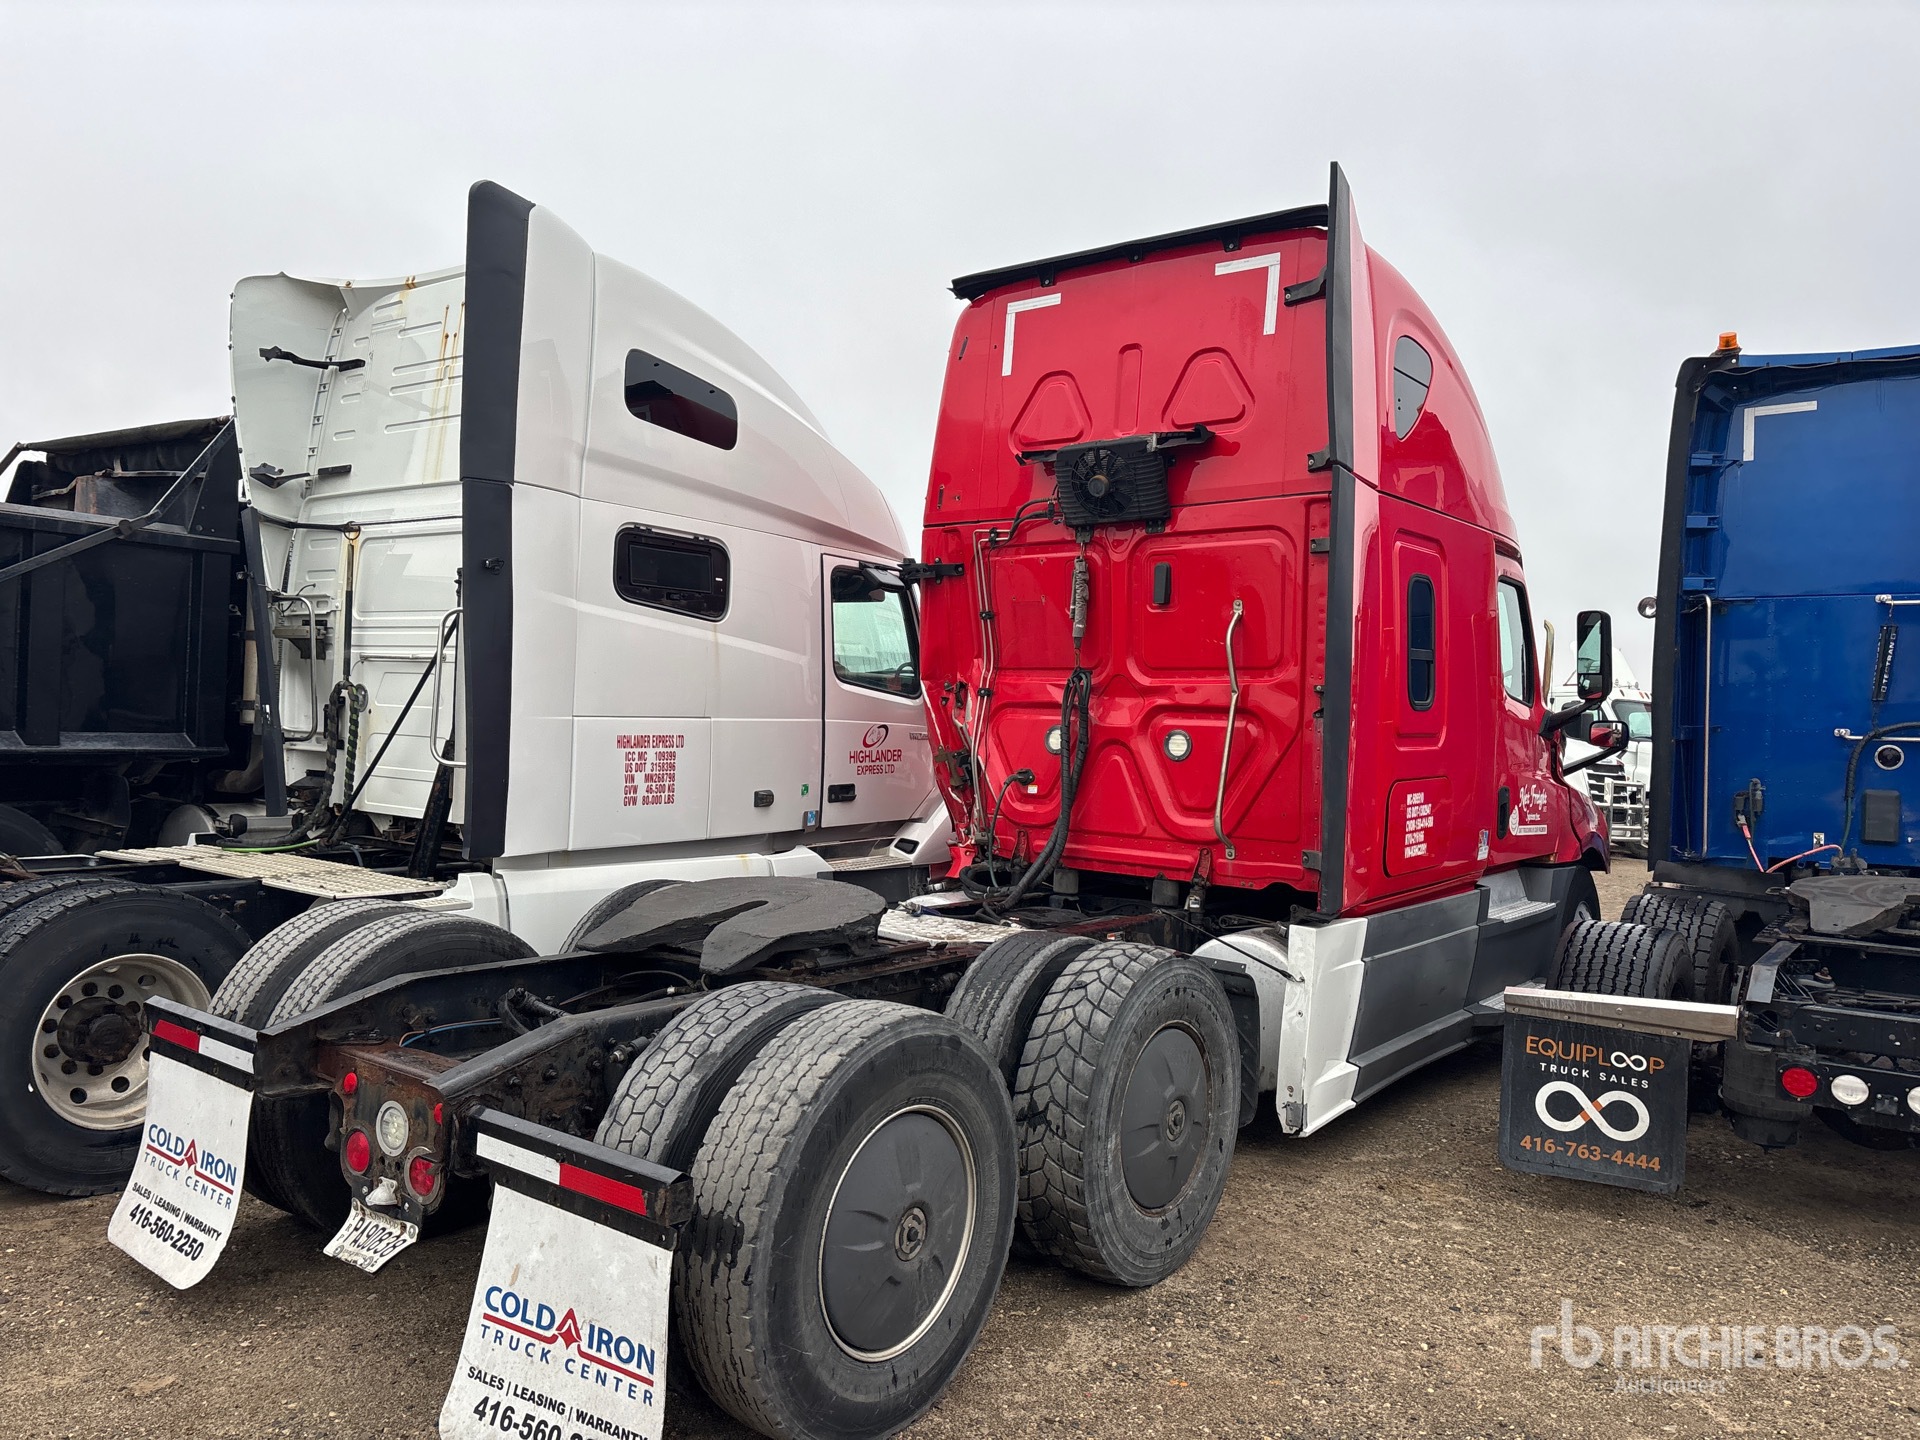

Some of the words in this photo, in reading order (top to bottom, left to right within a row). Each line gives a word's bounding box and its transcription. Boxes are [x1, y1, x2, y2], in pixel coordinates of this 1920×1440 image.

[616, 734, 651, 749] HIGHLANDER
[652, 734, 675, 749] EXPRESS
[676, 734, 685, 748] LTD
[625, 751, 636, 762] ICC
[637, 751, 648, 761] MC
[655, 750, 677, 761] 109399
[625, 762, 633, 773] US
[634, 762, 647, 773] DOT
[849, 749, 902, 764] HIGHLANDER
[856, 764, 884, 775] EXPRESS
[884, 763, 896, 774] LTD
[623, 784, 638, 795] GVW
[667, 783, 676, 793] KG
[624, 773, 635, 784] VIN
[623, 795, 638, 807] GVW
[663, 793, 675, 804] LBS
[1540, 1062, 1590, 1078] TRUCK
[1599, 1072, 1649, 1089] SALES
[148, 1123, 185, 1157] COLD
[200, 1149, 237, 1187] IRON
[1520, 1135, 1661, 1172] 416-763-4444
[144, 1151, 181, 1181] TRUCK
[185, 1175, 233, 1210] CENTER
[132, 1182, 152, 1201] SALES
[153, 1194, 182, 1218] LEASING
[183, 1211, 223, 1242] WARRANTY
[129, 1203, 205, 1261] 416-560-2250
[485, 1286, 556, 1331] COLD
[587, 1324, 656, 1376] IRON
[481, 1324, 552, 1365] TRUCK
[564, 1358, 654, 1407] CENTER
[467, 1366, 505, 1391] SALES
[512, 1384, 566, 1416] LEASING
